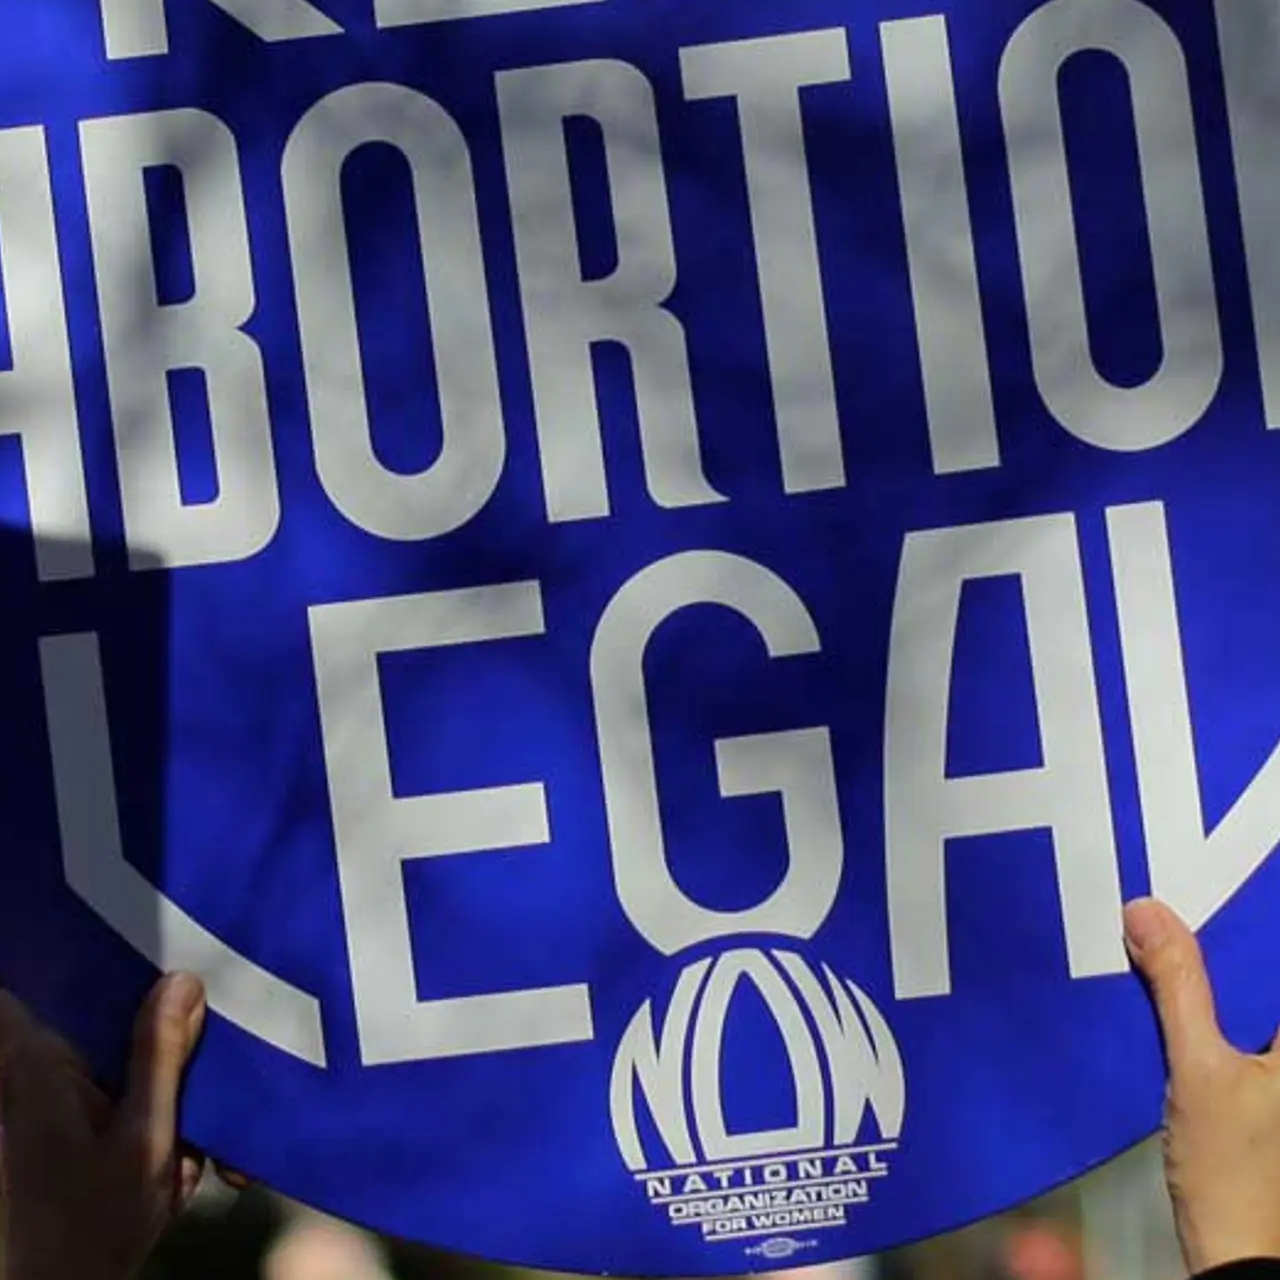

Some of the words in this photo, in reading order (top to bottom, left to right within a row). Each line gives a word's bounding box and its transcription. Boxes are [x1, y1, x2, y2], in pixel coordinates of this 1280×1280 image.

[609, 947, 907, 1172] NOW
[646, 1151, 889, 1198] NATIONAL
[668, 1180, 869, 1218] ORGANIZATION
[702, 1215, 747, 1235] FOR
[751, 1205, 845, 1231] WOMEN
